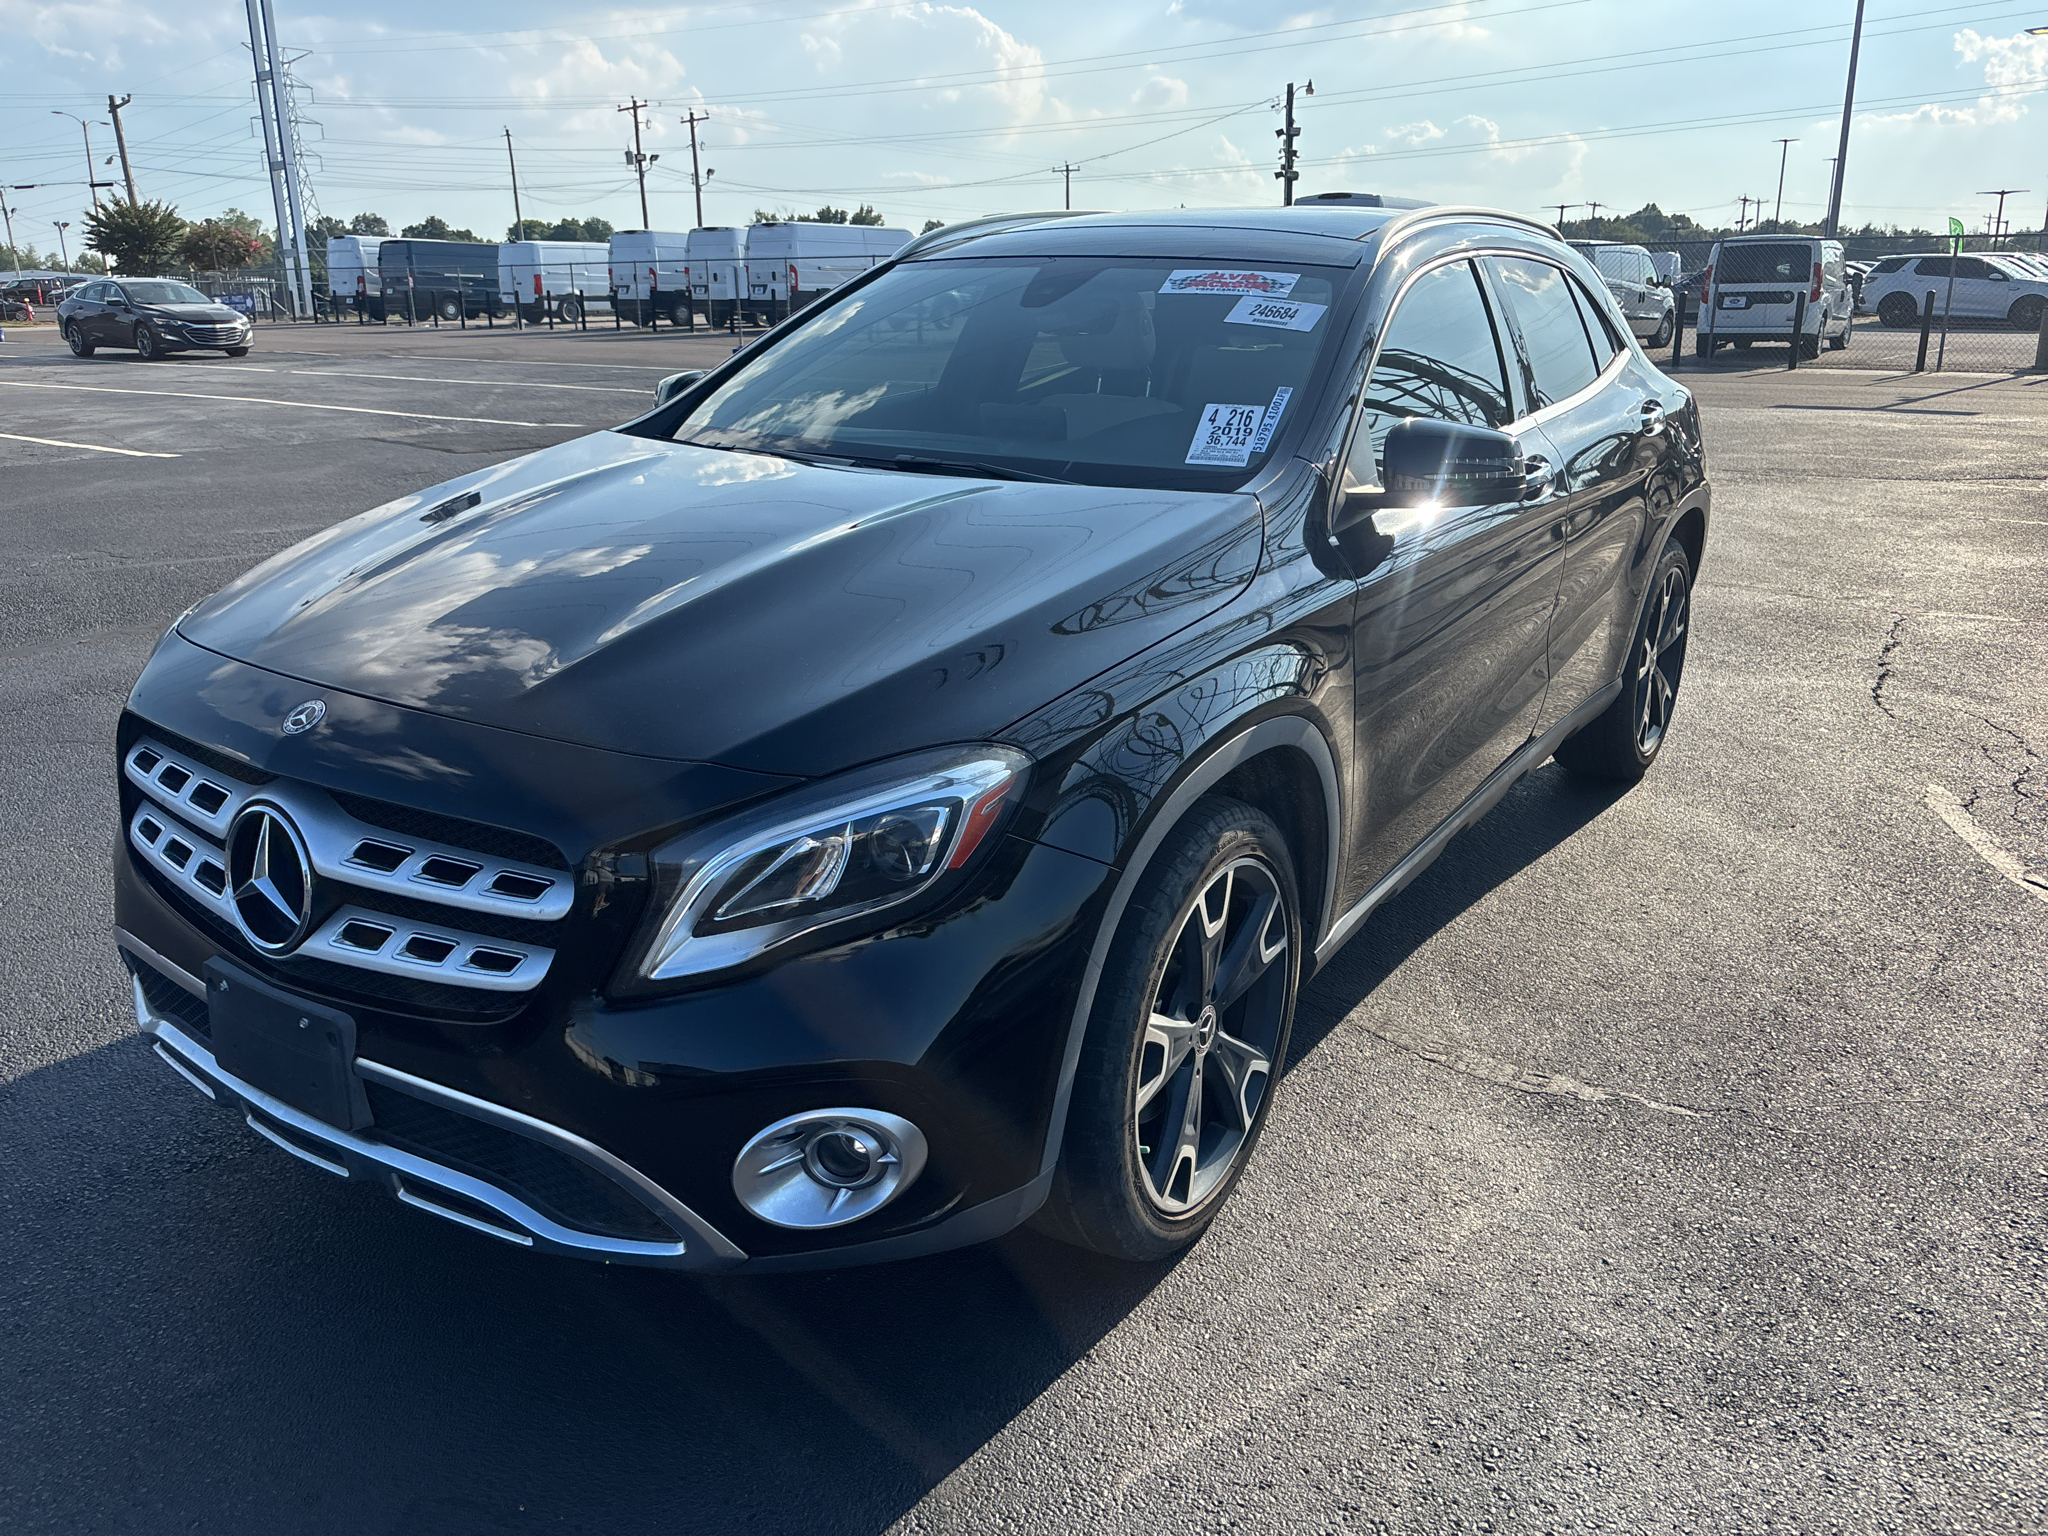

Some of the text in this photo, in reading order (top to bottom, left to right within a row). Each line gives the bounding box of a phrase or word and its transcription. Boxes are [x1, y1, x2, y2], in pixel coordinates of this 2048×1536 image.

[1204, 272, 1260, 281] ALVIN
[1185, 280, 1270, 290] JACKSON
[1249, 304, 1299, 321] 246684
[1208, 408, 1254, 427] 4 216
[1253, 394, 1286, 451] 519795 41001F
[1210, 426, 1253, 437] 2019
[1206, 435, 1247, 447] 36,744
